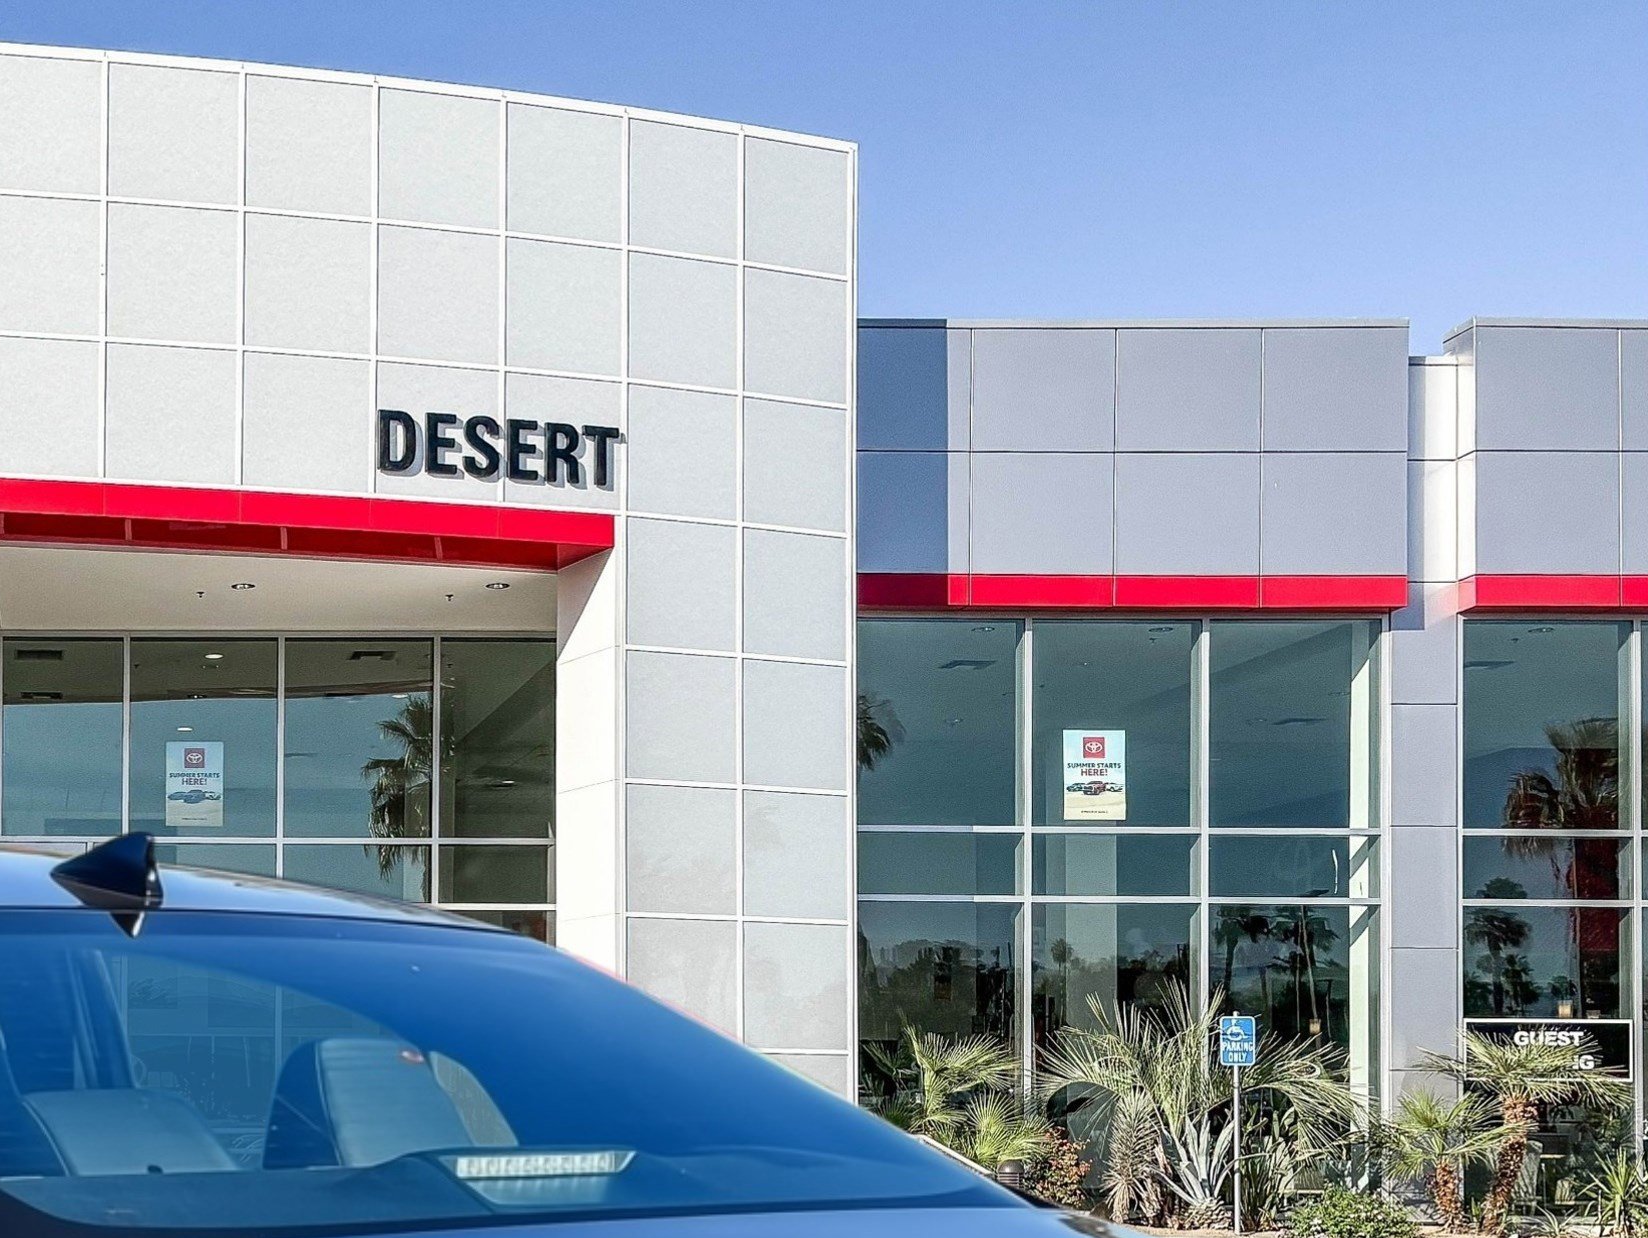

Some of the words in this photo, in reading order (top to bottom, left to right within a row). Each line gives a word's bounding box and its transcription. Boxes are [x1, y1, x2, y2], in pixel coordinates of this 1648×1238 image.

[377, 409, 620, 487] DESERT
[1513, 1030, 1584, 1046] GUEST
[1222, 1041, 1254, 1052] PARKING
[1228, 1051, 1248, 1062] ONLY
